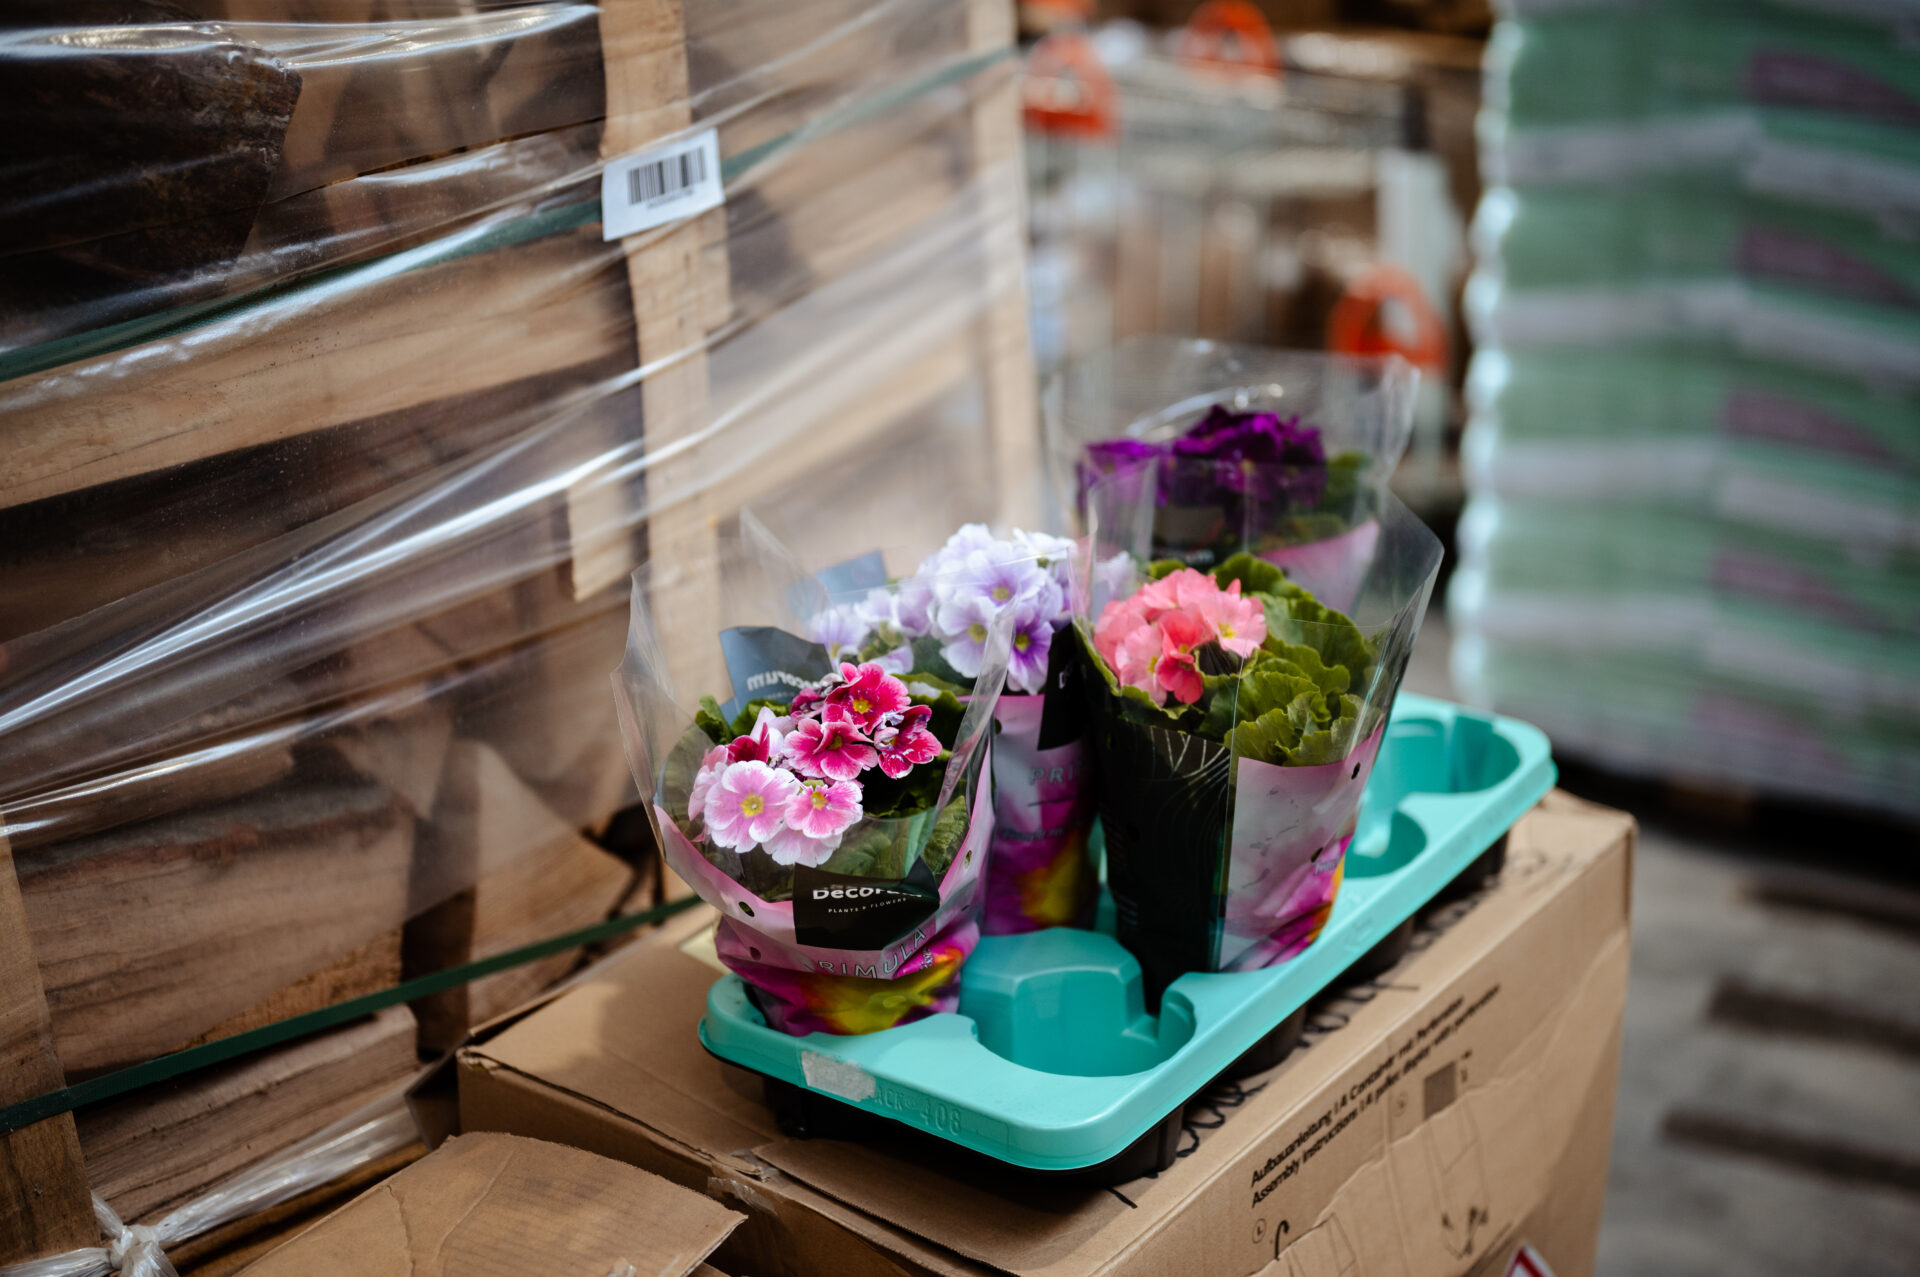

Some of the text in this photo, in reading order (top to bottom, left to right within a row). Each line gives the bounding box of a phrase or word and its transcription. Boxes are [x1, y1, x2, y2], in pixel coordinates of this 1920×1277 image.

[803, 928, 927, 980] RIMULA
[1251, 1110, 1332, 1188] Aufbauanleitung
[1251, 1158, 1300, 1208] Assembly
[1303, 1108, 1358, 1163] instructions
